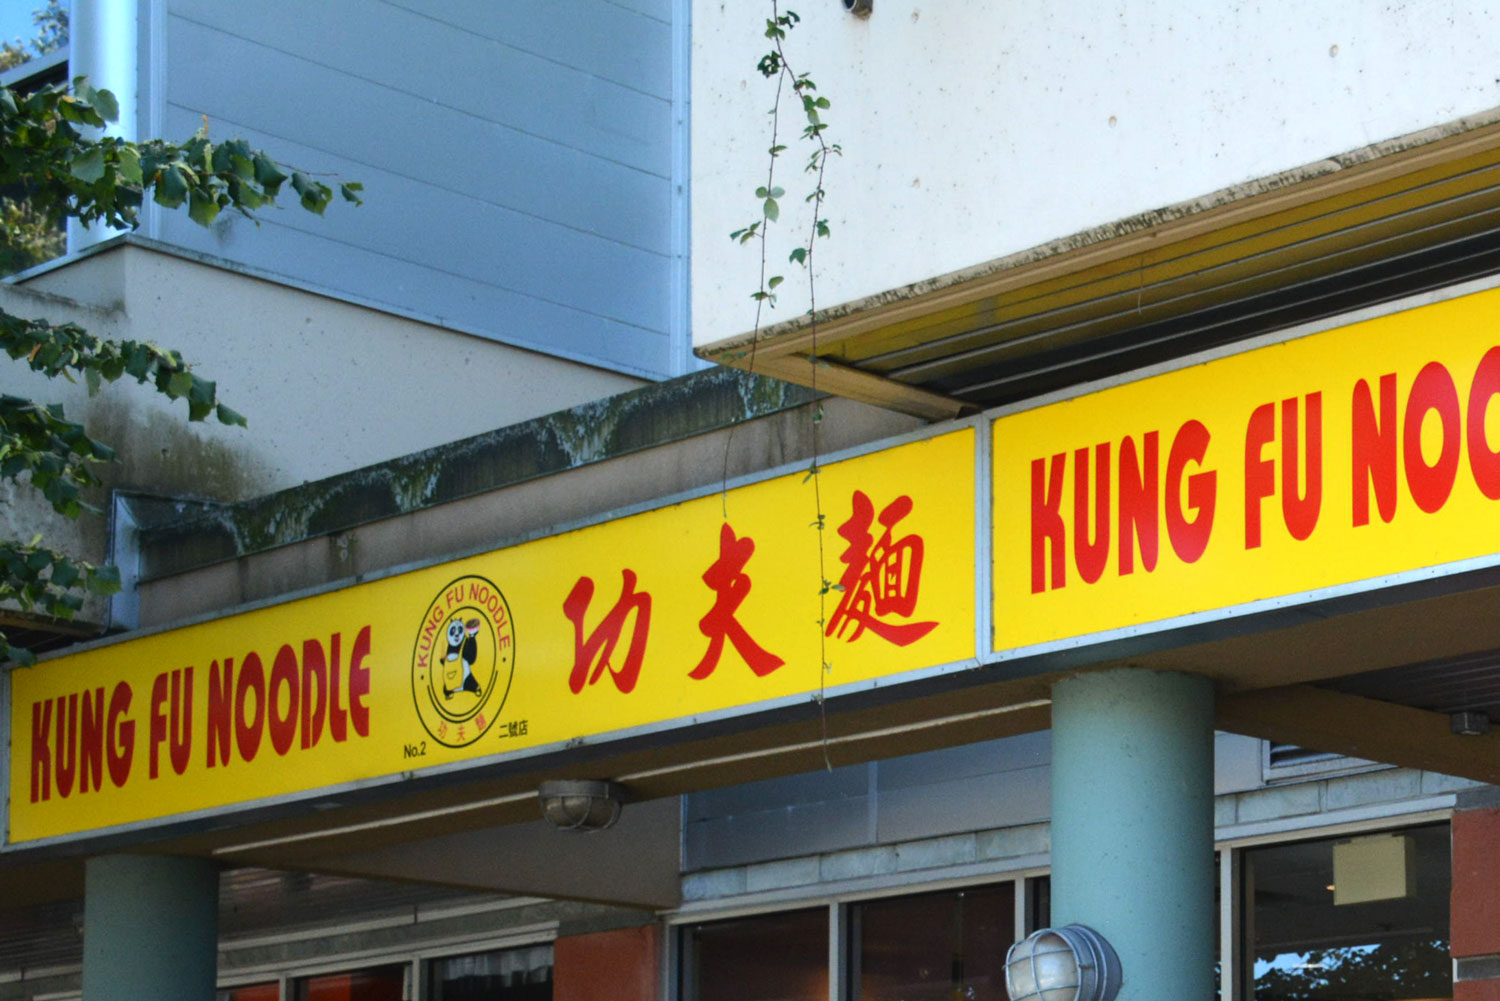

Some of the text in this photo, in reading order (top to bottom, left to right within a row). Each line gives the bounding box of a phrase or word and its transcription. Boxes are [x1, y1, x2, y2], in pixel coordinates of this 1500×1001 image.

[1031, 419, 1217, 594] KUNG
[1245, 391, 1323, 550] FU
[418, 583, 510, 668] KUNG FU NOODLE
[30, 625, 372, 803] KUNG FU NOODLE
[404, 741, 427, 759] No.2
